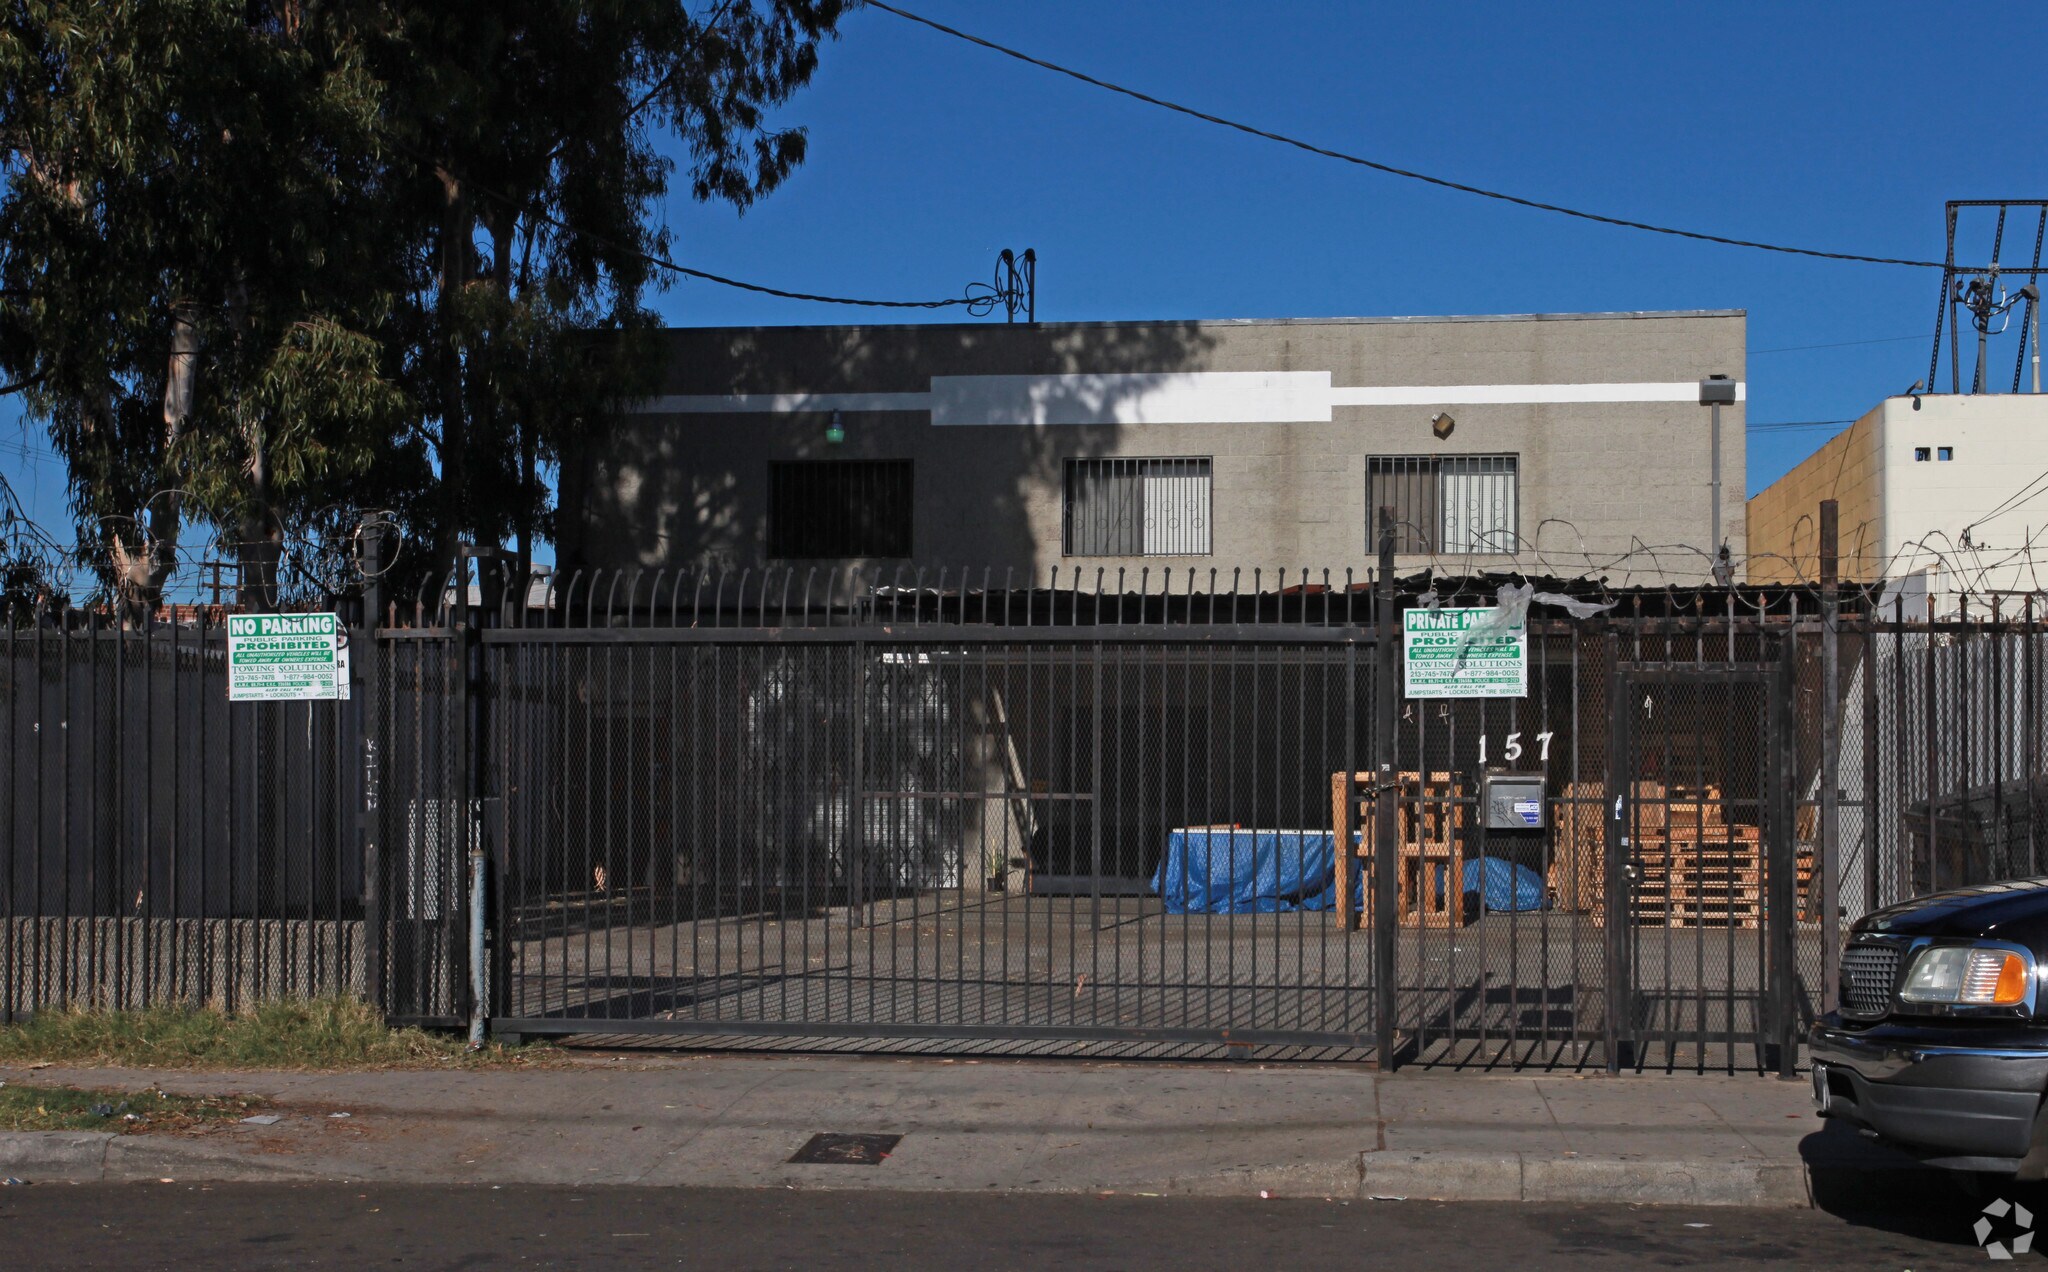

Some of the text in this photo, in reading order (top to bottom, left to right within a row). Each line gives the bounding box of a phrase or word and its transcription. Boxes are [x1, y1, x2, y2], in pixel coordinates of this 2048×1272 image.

[232, 616, 332, 635] NO PARKING
[1408, 612, 1458, 629] PRIVATE
[236, 641, 330, 650] PROHIBITED
[232, 663, 335, 674] TOWING SOLUTIONS
[1407, 660, 1522, 670] TOWING SOLUTIONS
[1479, 732, 1553, 763] 157
